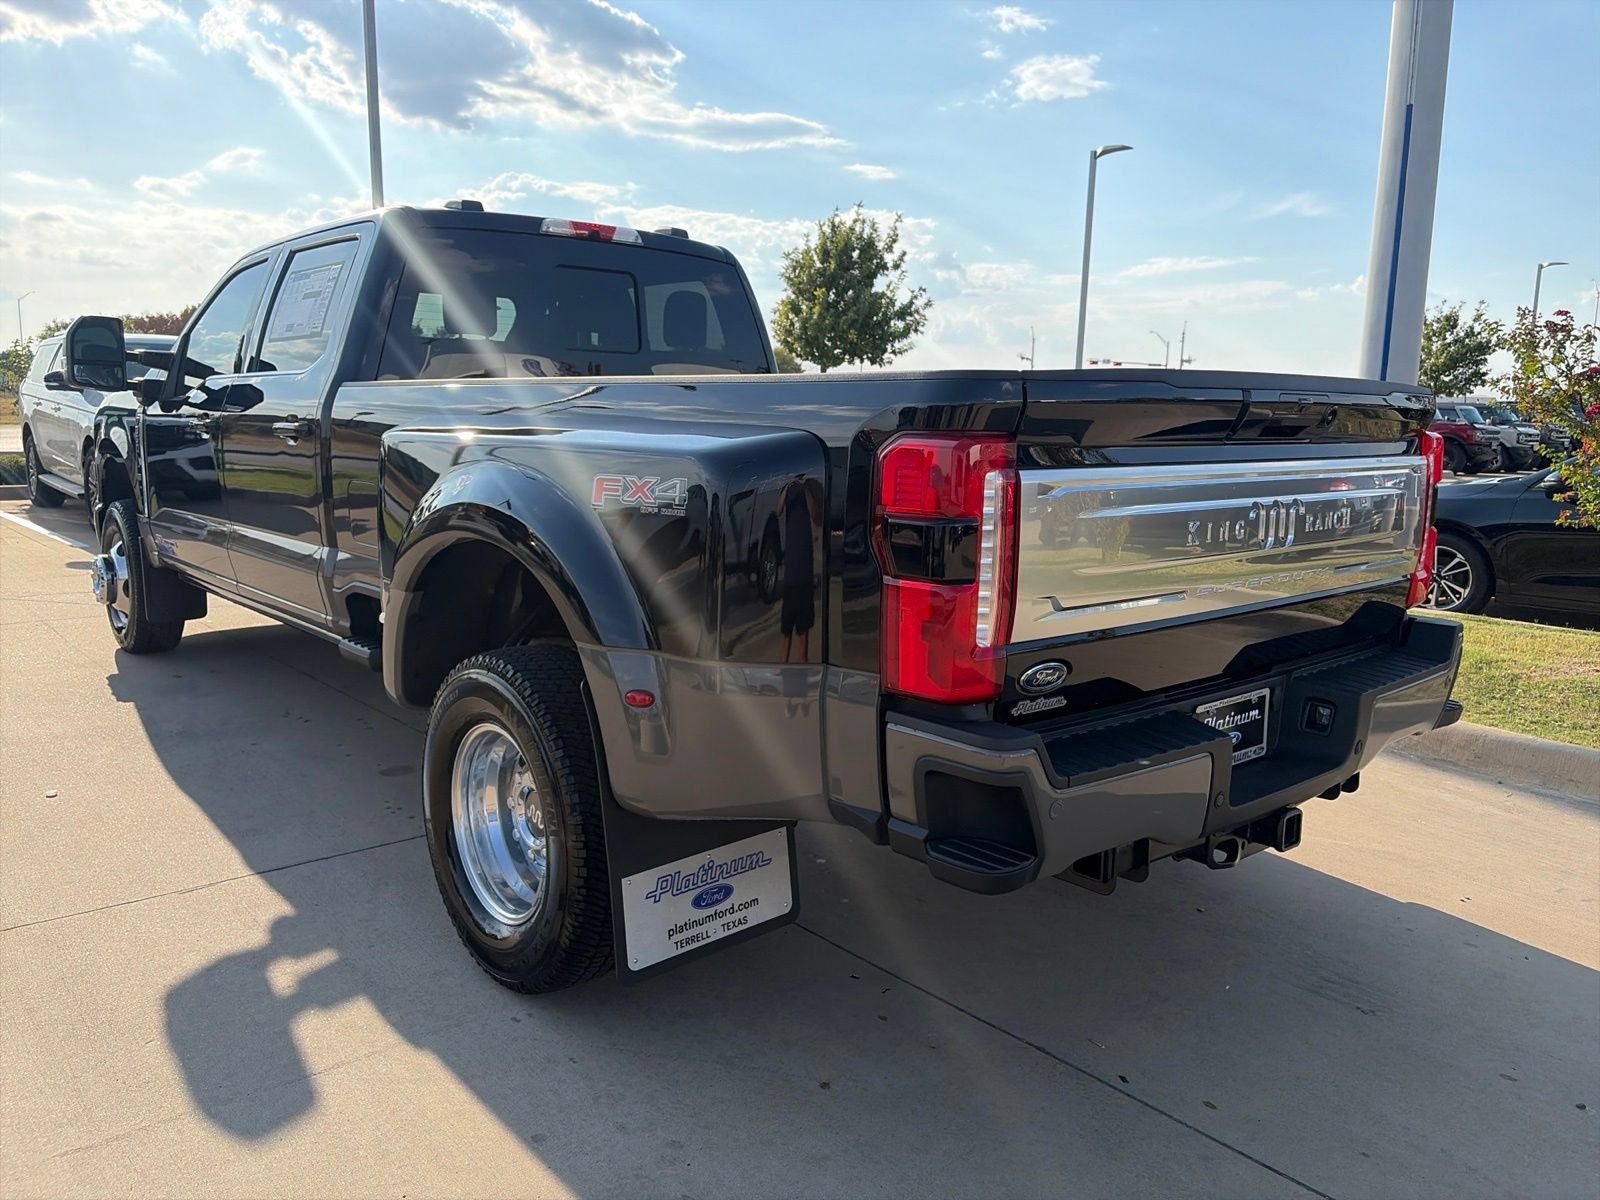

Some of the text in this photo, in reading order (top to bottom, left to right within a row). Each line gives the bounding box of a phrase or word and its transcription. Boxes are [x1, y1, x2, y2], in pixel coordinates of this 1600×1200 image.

[591, 473, 688, 509] FX4
[1186, 507, 1351, 547] KING RANCH
[1010, 695, 1067, 717] Platinum
[645, 850, 773, 904] Platinum
[667, 897, 760, 940] platinumford.com
[673, 915, 749, 951] TERRELL TEXAS
